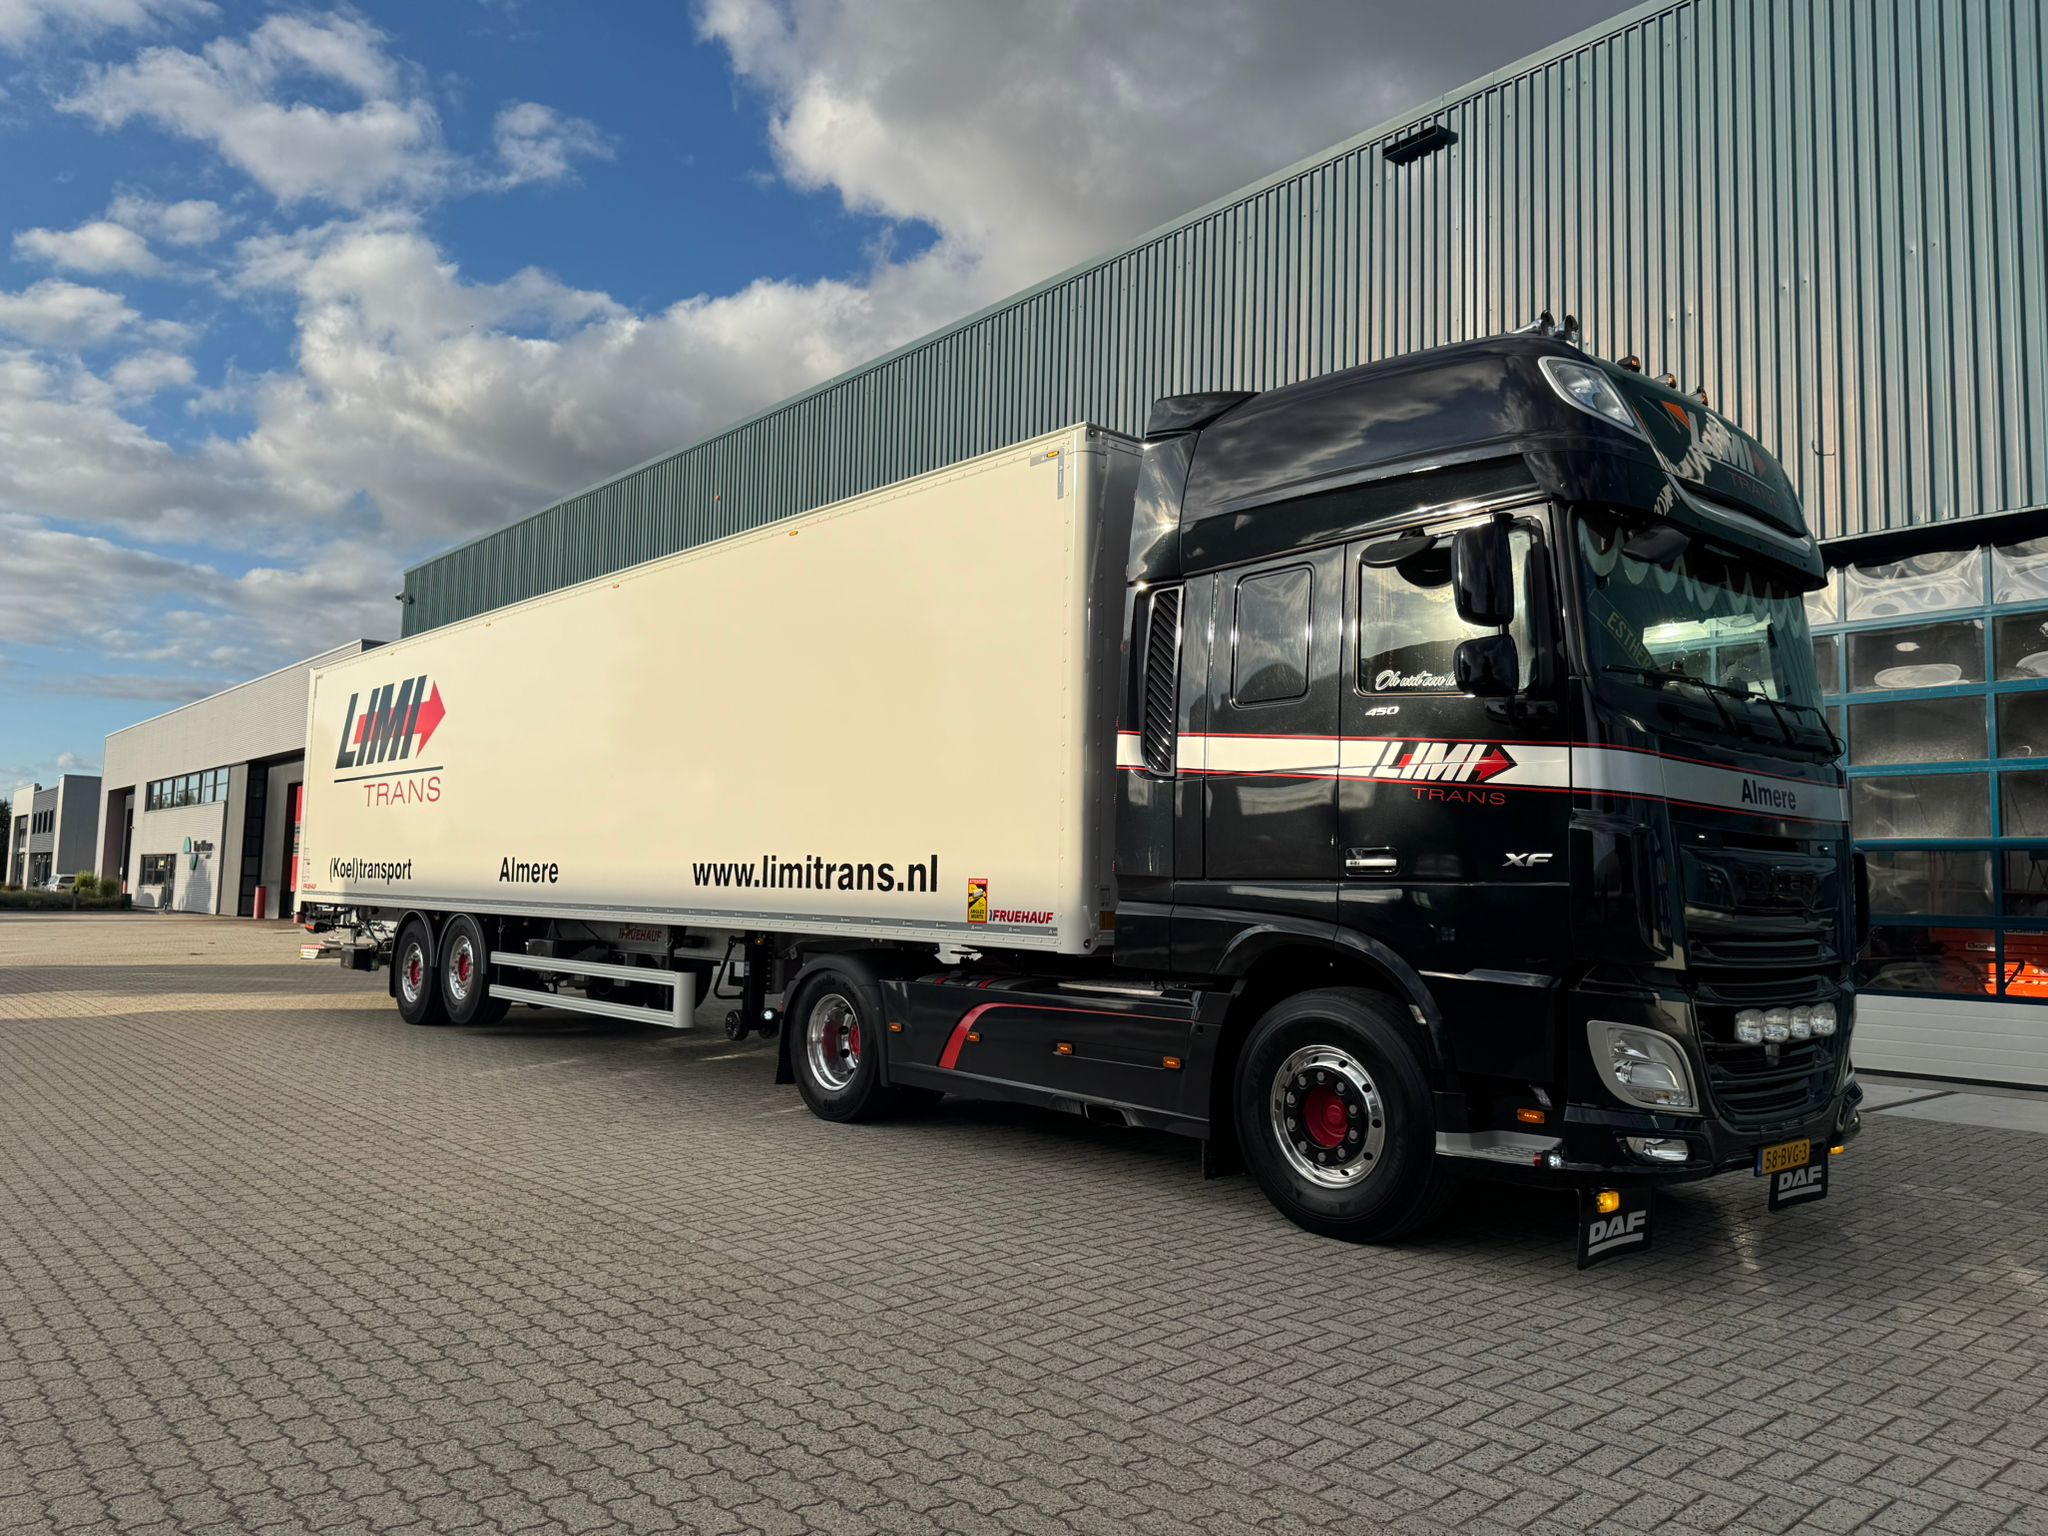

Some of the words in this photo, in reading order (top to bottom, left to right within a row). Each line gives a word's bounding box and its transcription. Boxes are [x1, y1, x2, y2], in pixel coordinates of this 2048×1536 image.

[334, 674, 428, 770] LIMI
[1365, 705, 1400, 716] 450
[1372, 741, 1488, 783] LIMI
[363, 776, 442, 807] TRANS
[1411, 787, 1506, 806] TRANS
[1741, 778, 1797, 810] Almere
[329, 856, 412, 885] (Koel)transport
[499, 857, 559, 884] Almere
[692, 854, 938, 892] www.limitrans.nl
[1501, 852, 1553, 868] XF
[992, 910, 1054, 925] FRUEHAUF
[1765, 1143, 1808, 1170] 58-BVG-3
[1778, 1165, 1822, 1191] DAF
[1588, 1209, 1647, 1245] DAF
